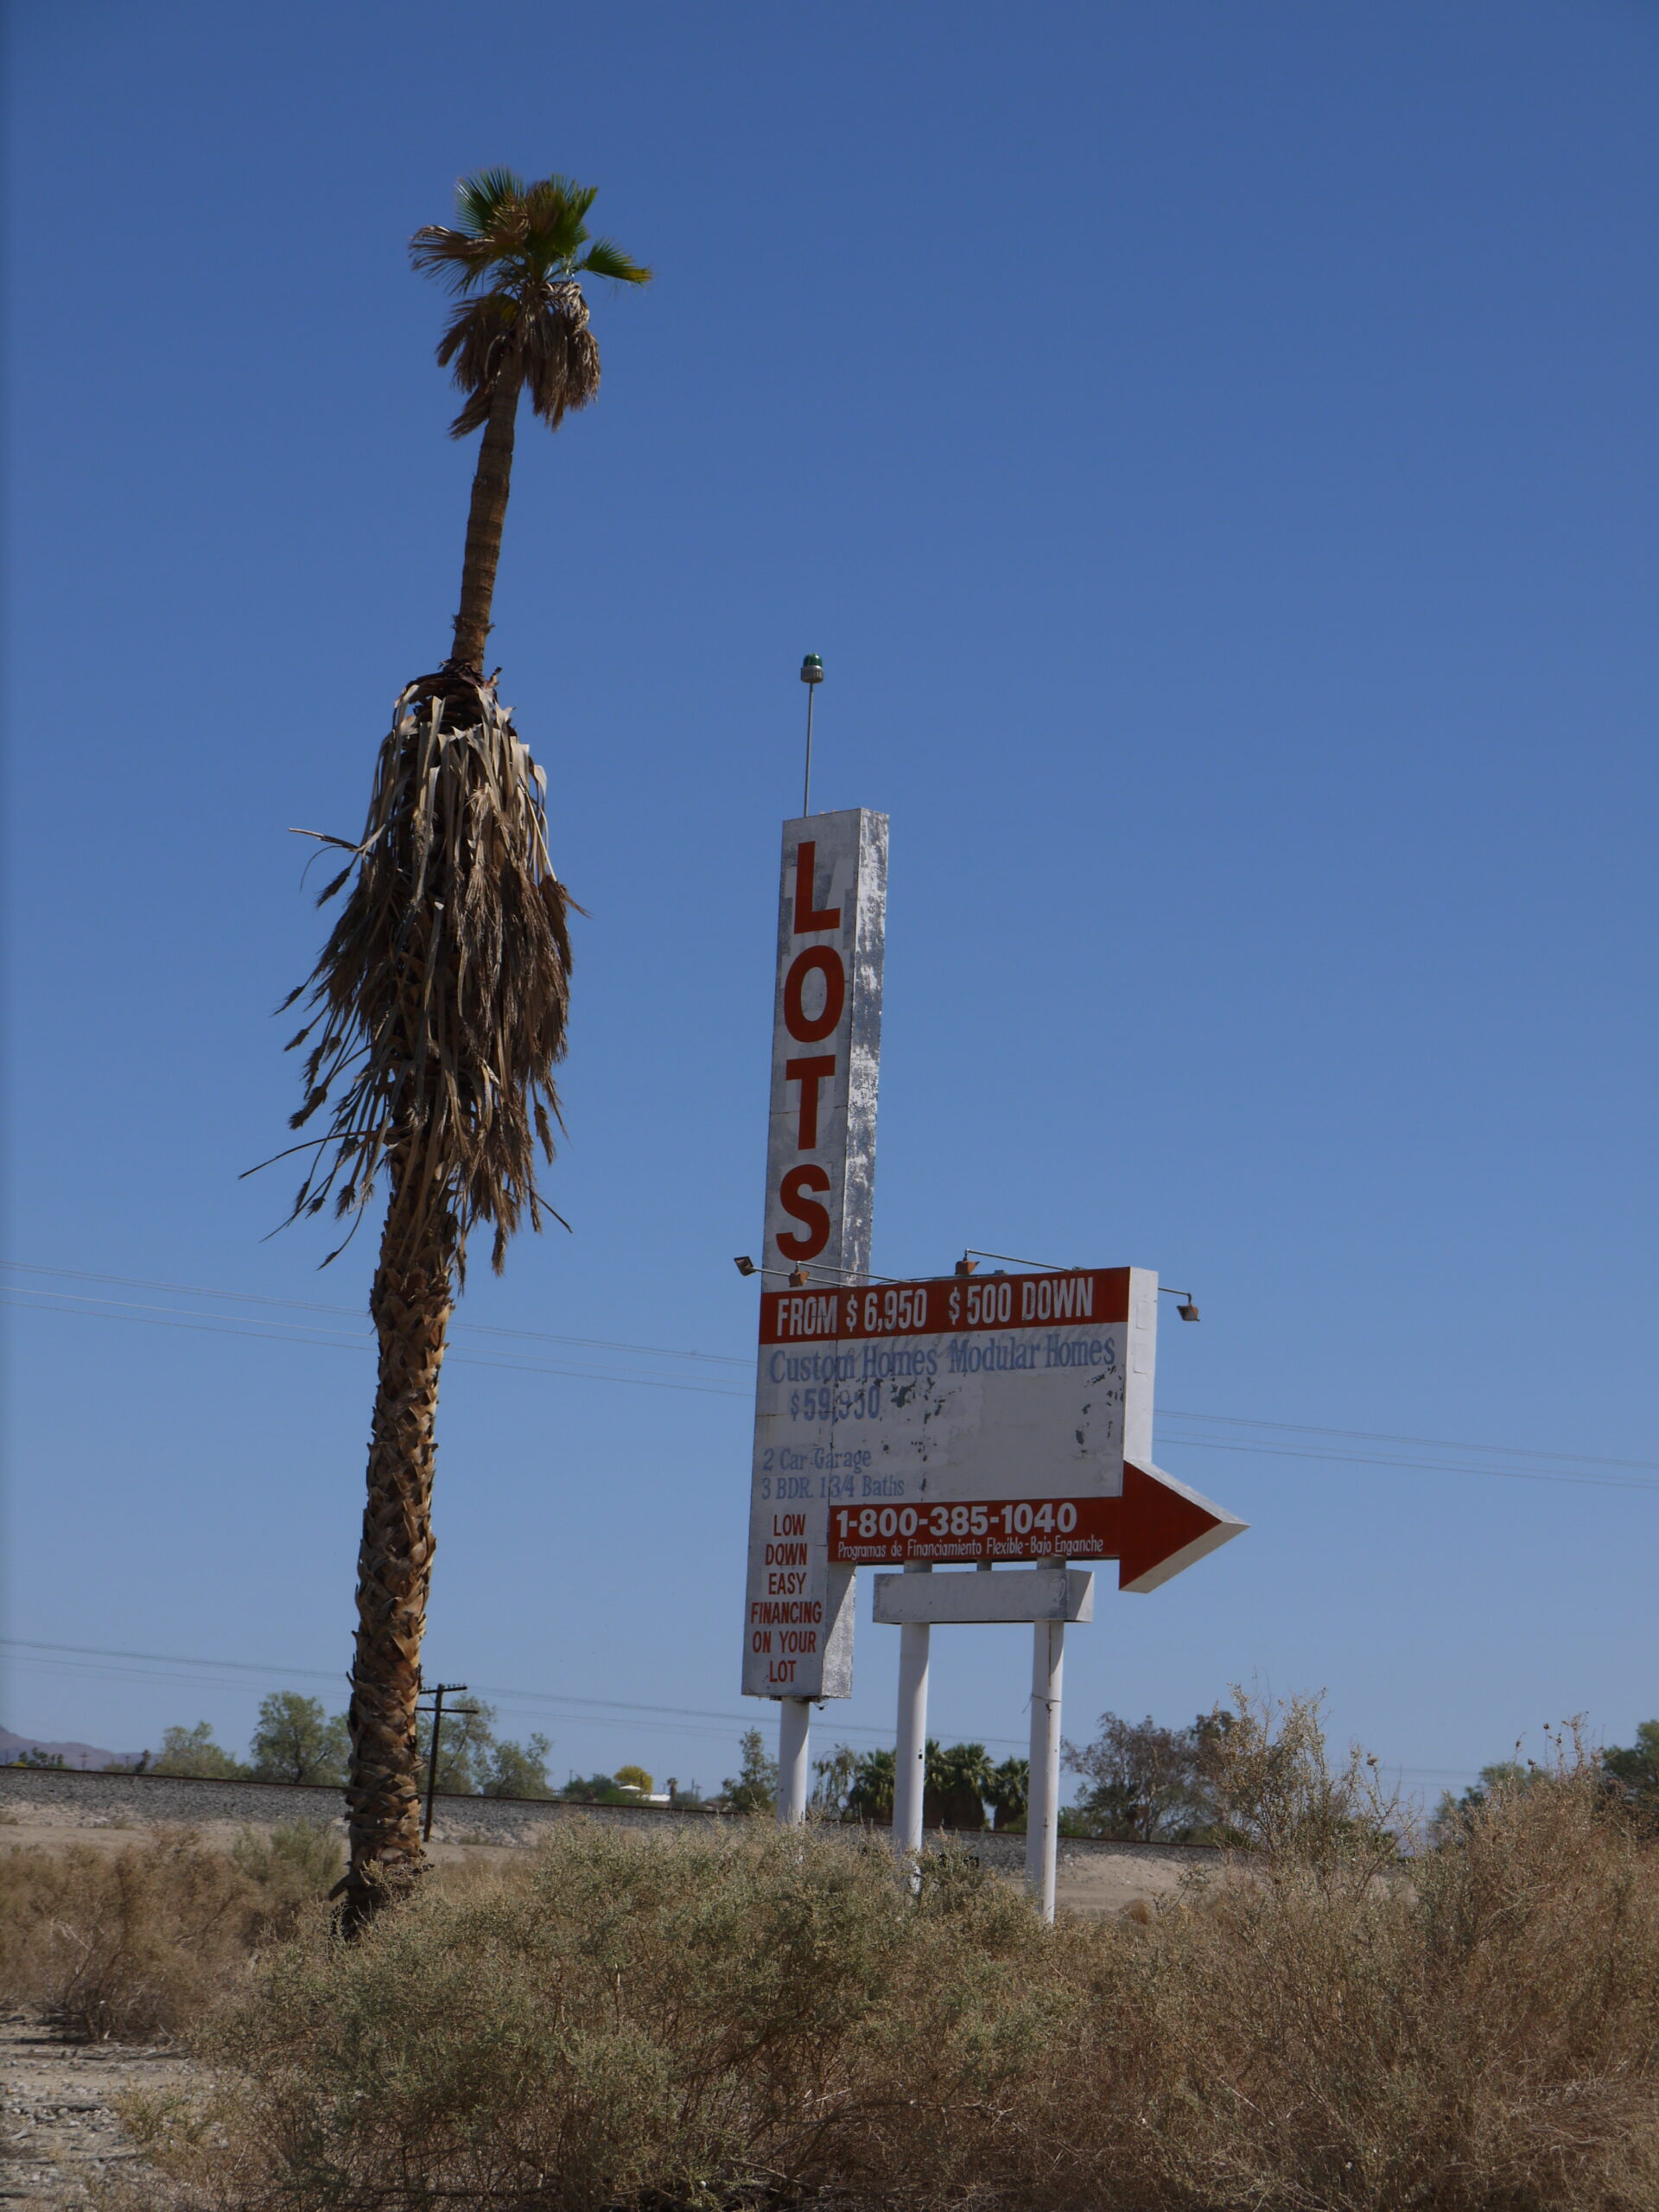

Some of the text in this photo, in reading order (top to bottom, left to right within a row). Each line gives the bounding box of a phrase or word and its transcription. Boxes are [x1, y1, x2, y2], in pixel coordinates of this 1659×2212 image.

[776, 841, 846, 1261] LOTS
[778, 1295, 837, 1336] FROM
[1022, 1277, 1093, 1319] DOWN
[769, 1333, 1116, 1382] Custom Homes Modular Homes
[764, 1447, 872, 1473] 2 Car Garage
[762, 1477, 771, 1500] 3
[861, 1475, 905, 1497] Baths
[773, 1513, 806, 1536] LOW
[836, 1503, 1077, 1538] 1-800-385-1040
[766, 1542, 808, 1566] DOWN
[838, 1541, 887, 1560] Programas
[891, 1541, 902, 1556] de
[908, 1535, 982, 1557] Financiamiento
[1055, 1535, 1103, 1556] Enganche
[768, 1572, 807, 1595] EASY
[751, 1601, 823, 1624] FINANCING
[753, 1630, 817, 1654] ON YOUR
[769, 1660, 797, 1683] LOT
